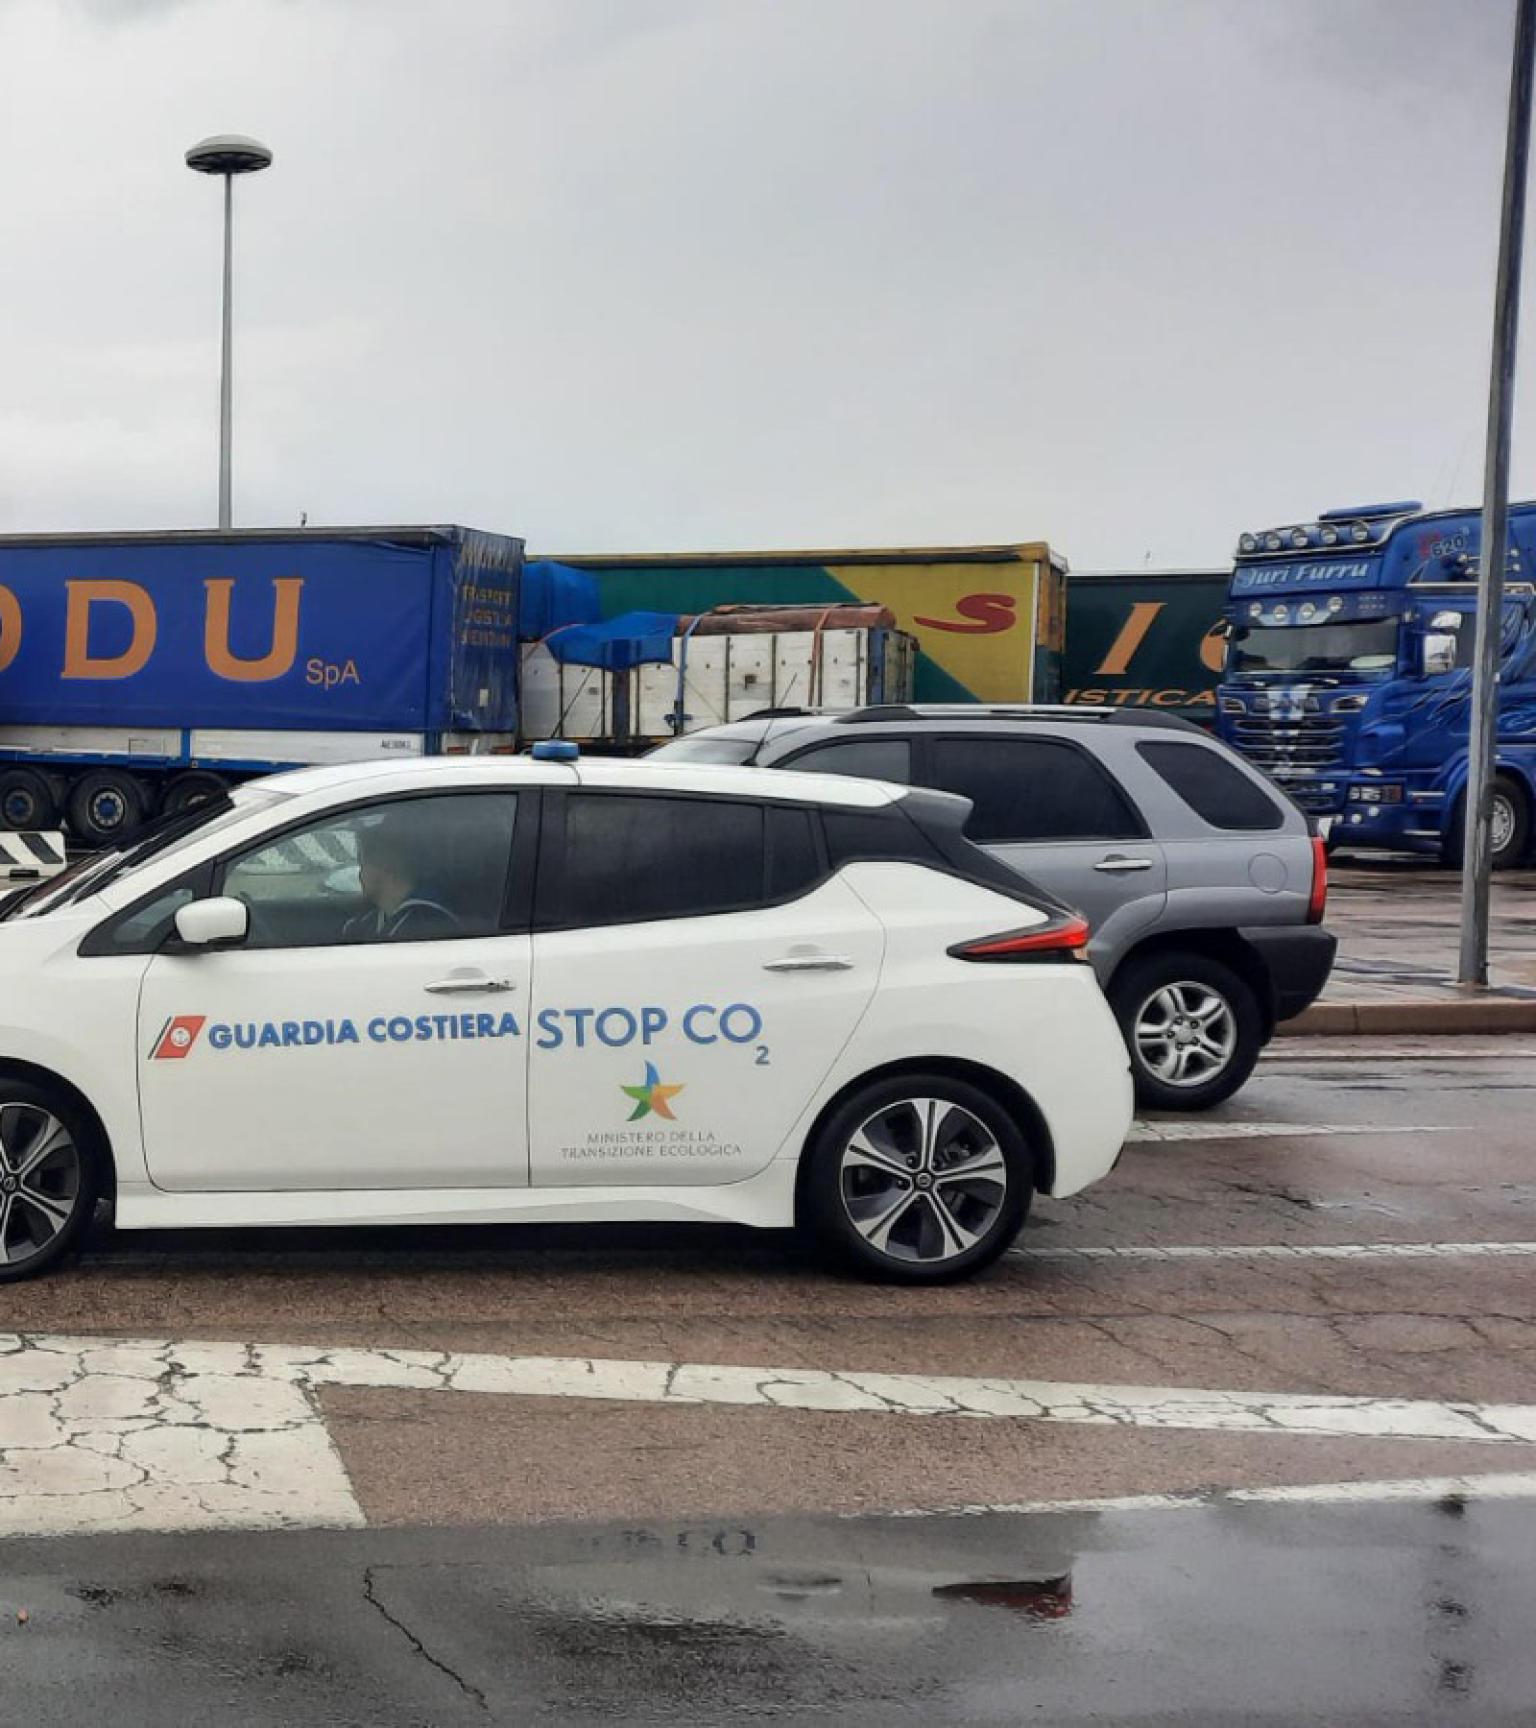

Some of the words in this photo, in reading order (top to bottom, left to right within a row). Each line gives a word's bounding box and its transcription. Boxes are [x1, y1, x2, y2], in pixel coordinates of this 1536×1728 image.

[305, 657, 361, 690] SpA
[208, 1018, 360, 1049] GUARDIA
[367, 1011, 521, 1043] COSTIERA
[536, 1006, 669, 1049] STOP
[561, 1146, 653, 1160] TRANSIZIONE
[659, 1144, 742, 1157] ECOLOGICA
[587, 1131, 665, 1145] MINISTERO
[670, 1130, 715, 1142] DELLA
